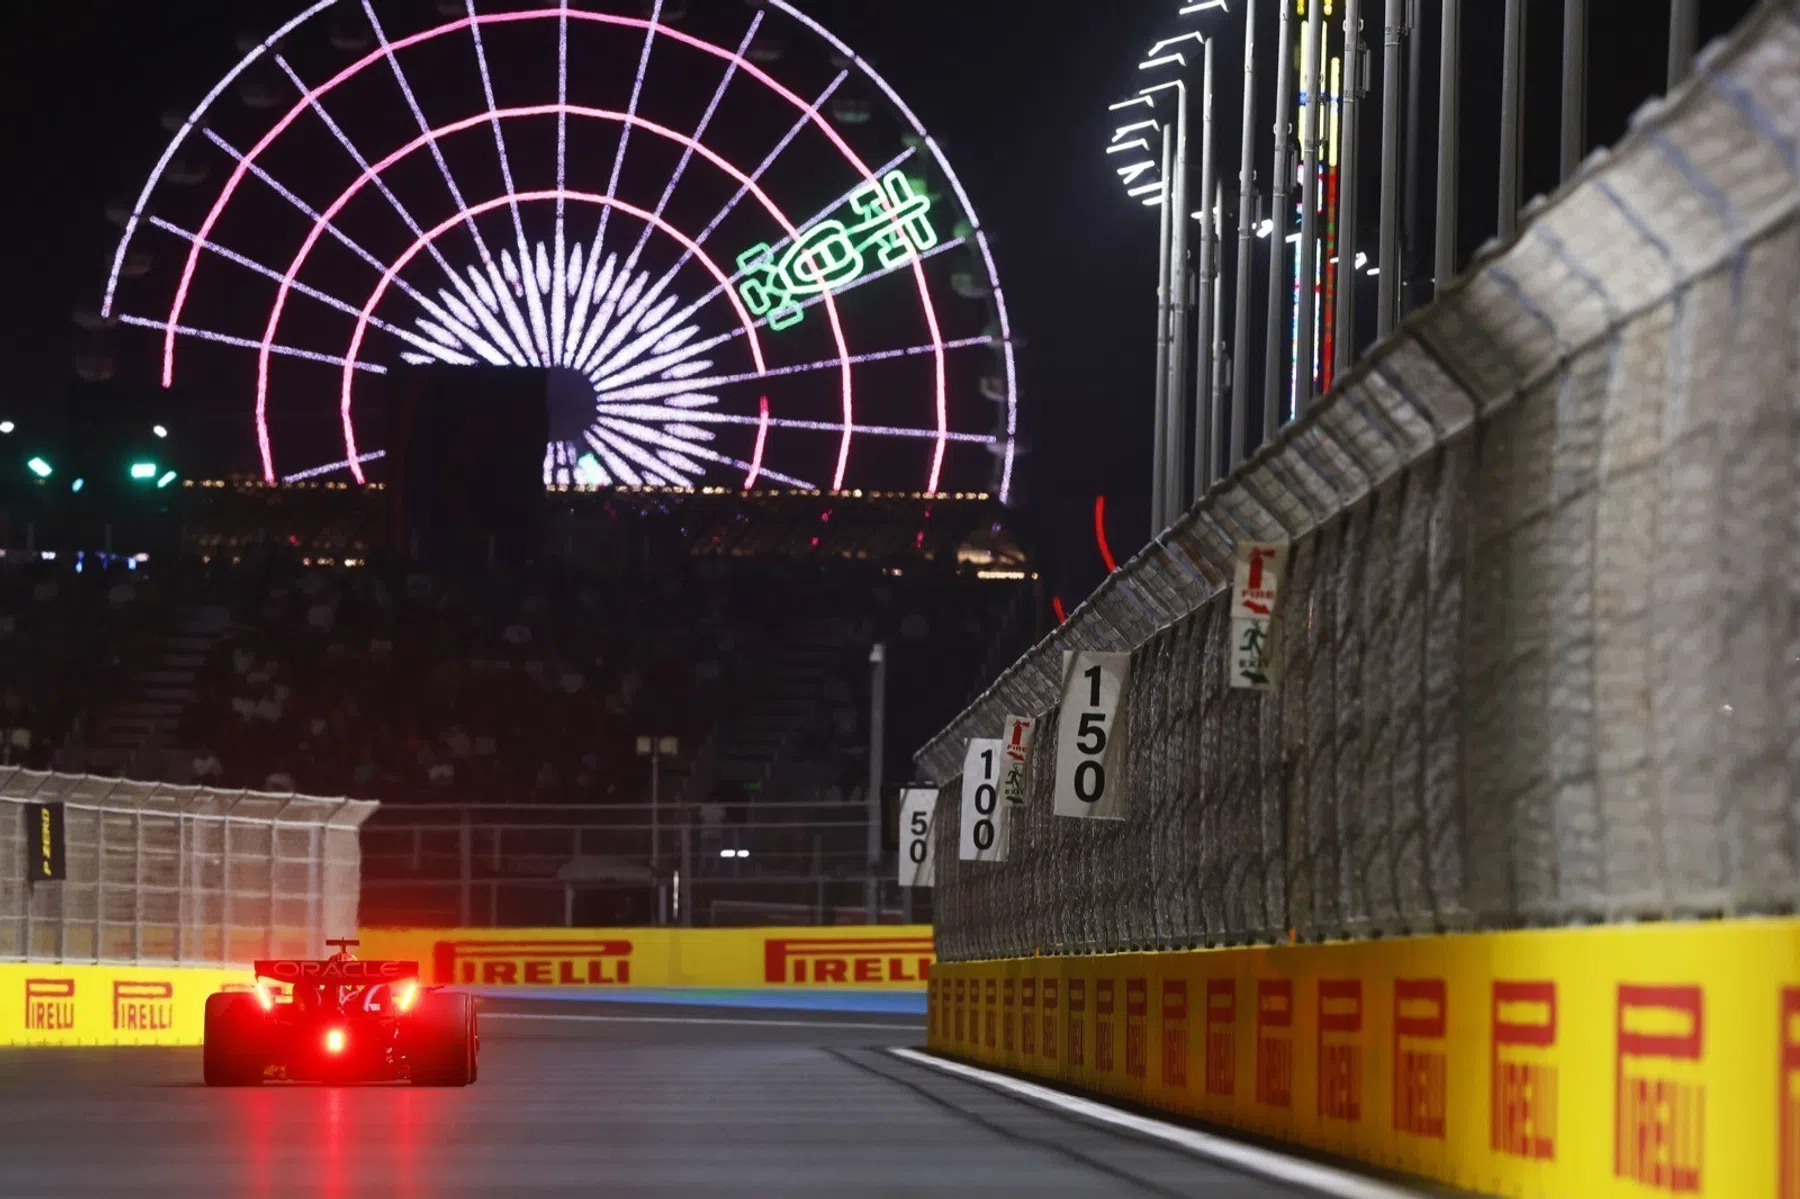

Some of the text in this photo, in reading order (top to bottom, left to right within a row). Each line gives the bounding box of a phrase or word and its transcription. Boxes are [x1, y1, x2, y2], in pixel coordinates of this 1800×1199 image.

[1241, 589, 1274, 600] FIRE
[1007, 743, 1027, 753] FIRE
[1074, 665, 1108, 804] 150
[973, 749, 997, 851] 100
[909, 811, 928, 865] 50
[273, 961, 401, 978] ORACLE
[433, 940, 632, 985] PIRELLI
[25, 978, 75, 1030] PIRELLI
[113, 980, 173, 1030] PIRELLI
